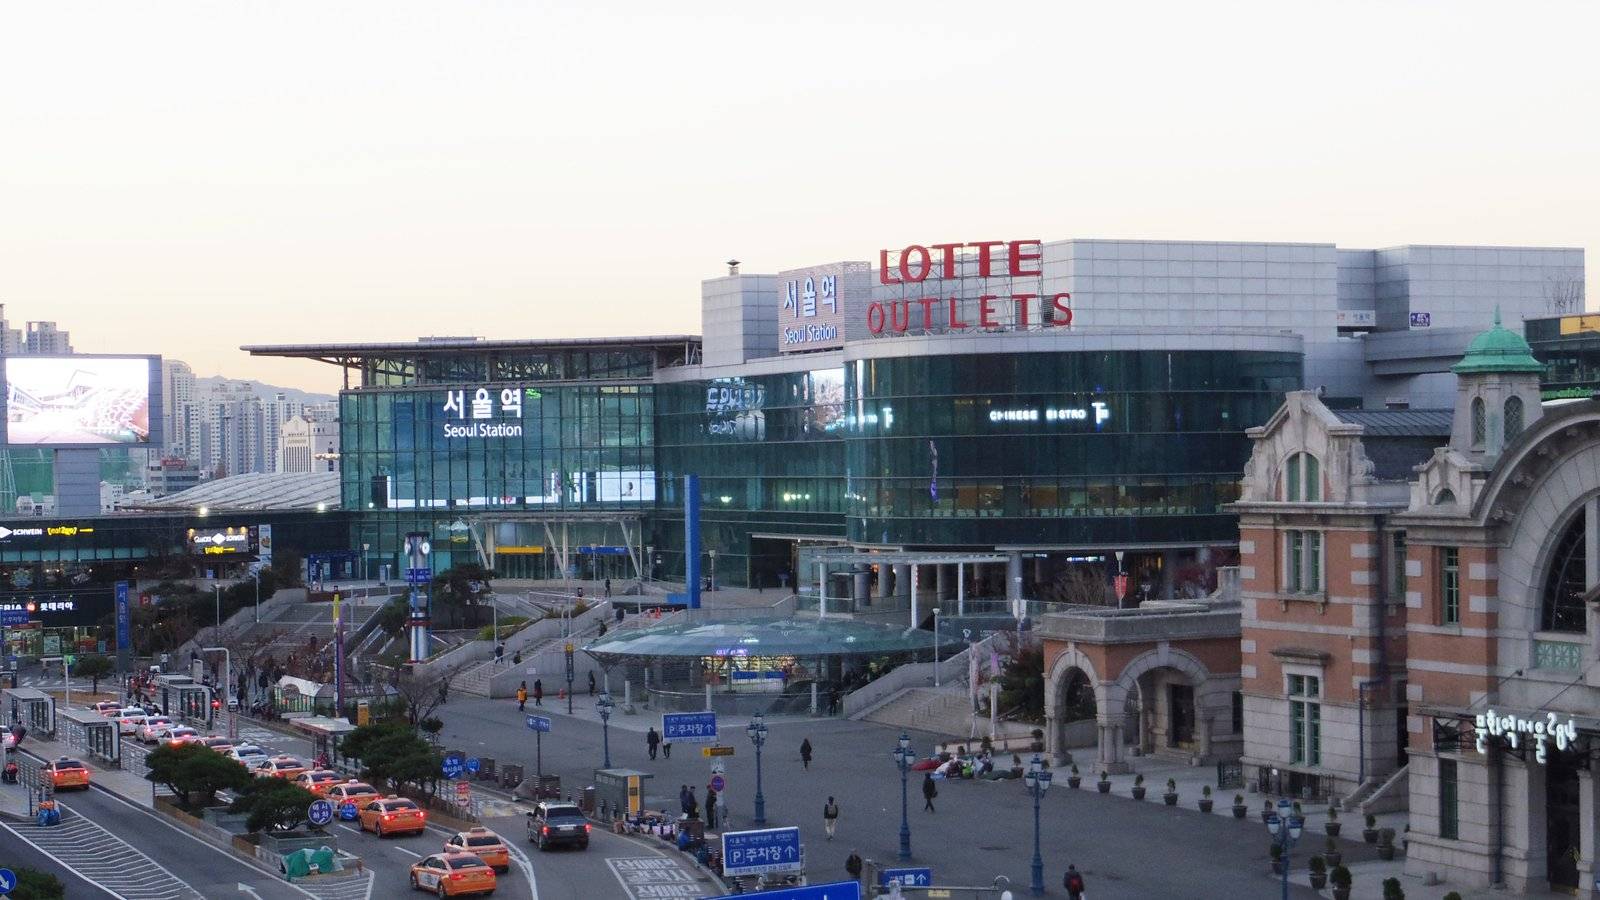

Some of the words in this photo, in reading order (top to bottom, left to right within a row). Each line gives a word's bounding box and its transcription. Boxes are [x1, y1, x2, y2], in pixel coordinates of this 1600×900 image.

[880, 239, 1041, 285] LOTTE
[784, 275, 836, 317] 서울역
[867, 292, 1073, 334] OUTLETS
[784, 326, 806, 344] Seoul
[808, 323, 837, 341] Station
[443, 388, 521, 419] 서울역
[1046, 409, 1086, 420] BISTRO
[444, 422, 477, 437] Seoul
[480, 423, 522, 437] Station
[12, 528, 43, 536] SCHWEIN
[40, 601, 73, 611] 롯데리아
[678, 723, 704, 734] 주차장
[746, 846, 781, 862] 주차장
